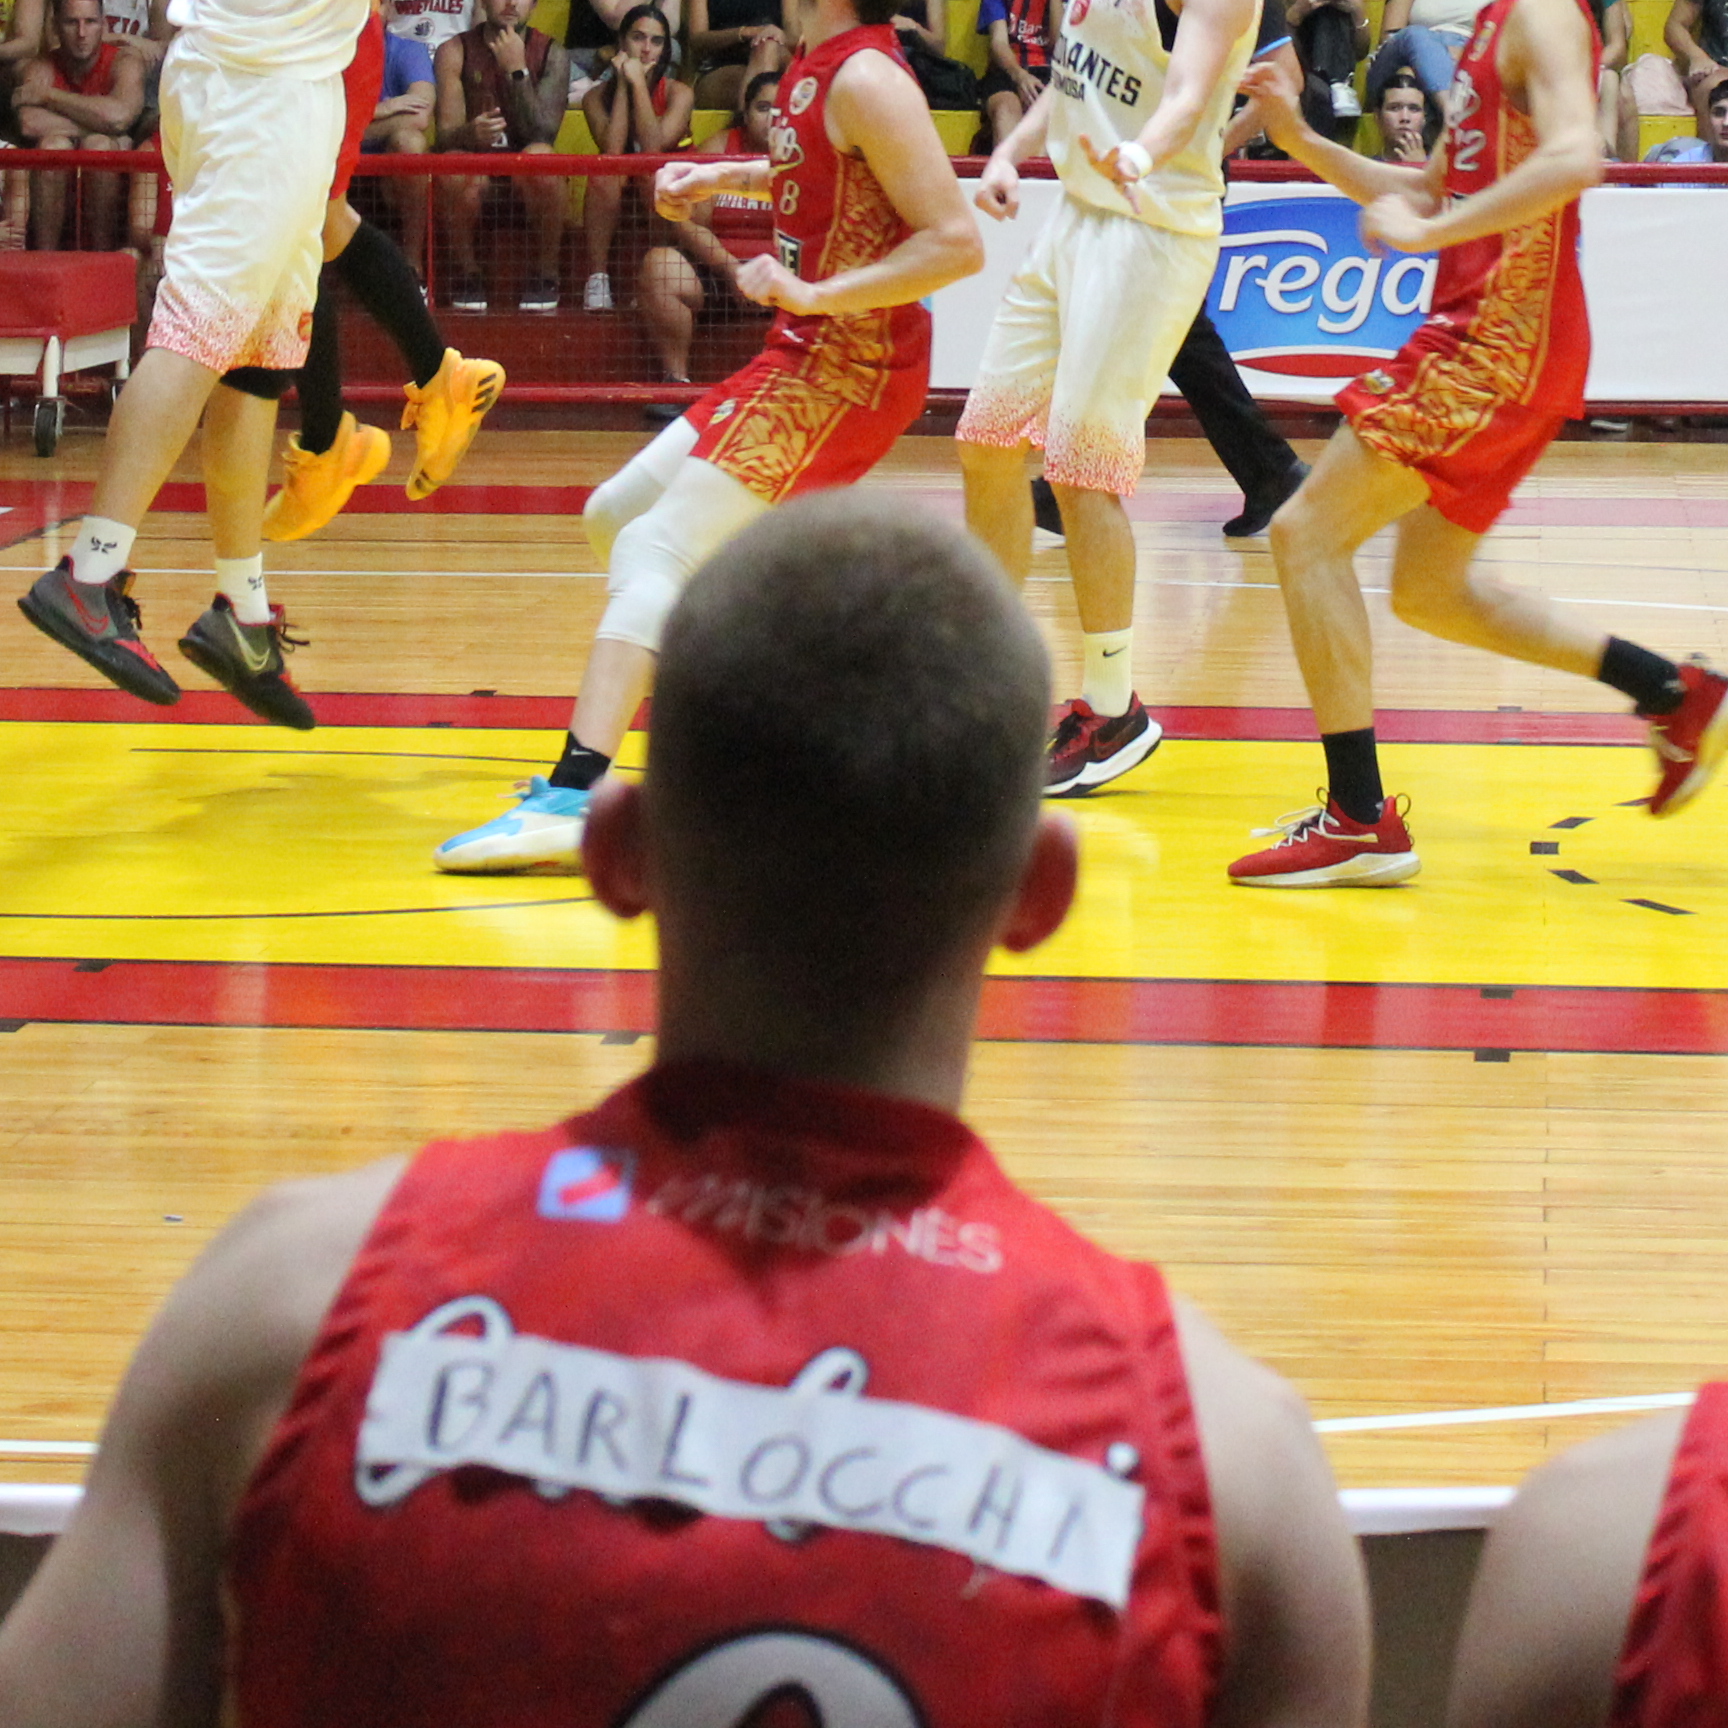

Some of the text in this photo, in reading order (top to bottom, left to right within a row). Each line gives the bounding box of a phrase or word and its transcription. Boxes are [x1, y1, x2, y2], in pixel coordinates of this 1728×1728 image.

[779, 179, 801, 216] 8
[1218, 229, 1435, 334] rega
[424, 1360, 1087, 1563] BARLOCCHI
